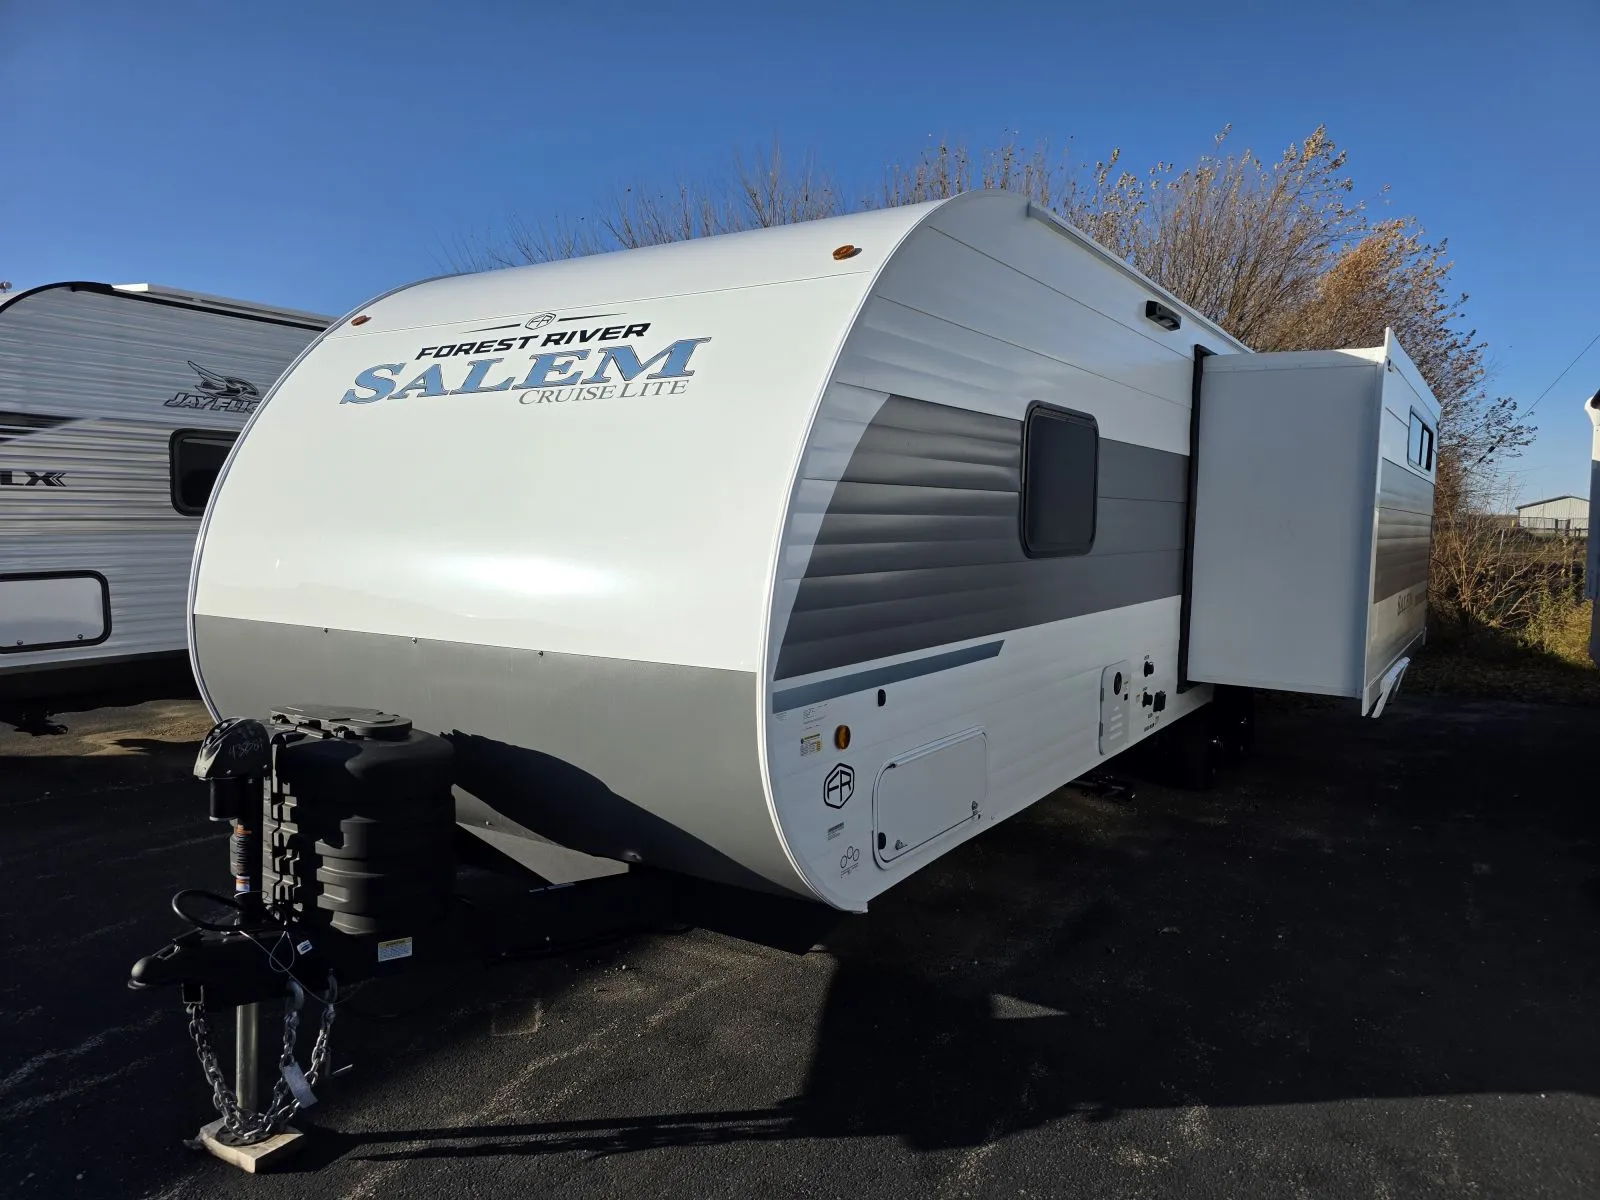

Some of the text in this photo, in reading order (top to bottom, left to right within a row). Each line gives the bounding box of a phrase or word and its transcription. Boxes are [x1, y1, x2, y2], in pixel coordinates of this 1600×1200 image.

[415, 322, 651, 360] FOREST RIVER
[339, 336, 712, 405] SALEM
[163, 392, 216, 410] JAY
[519, 379, 690, 405] CRUISE LITE
